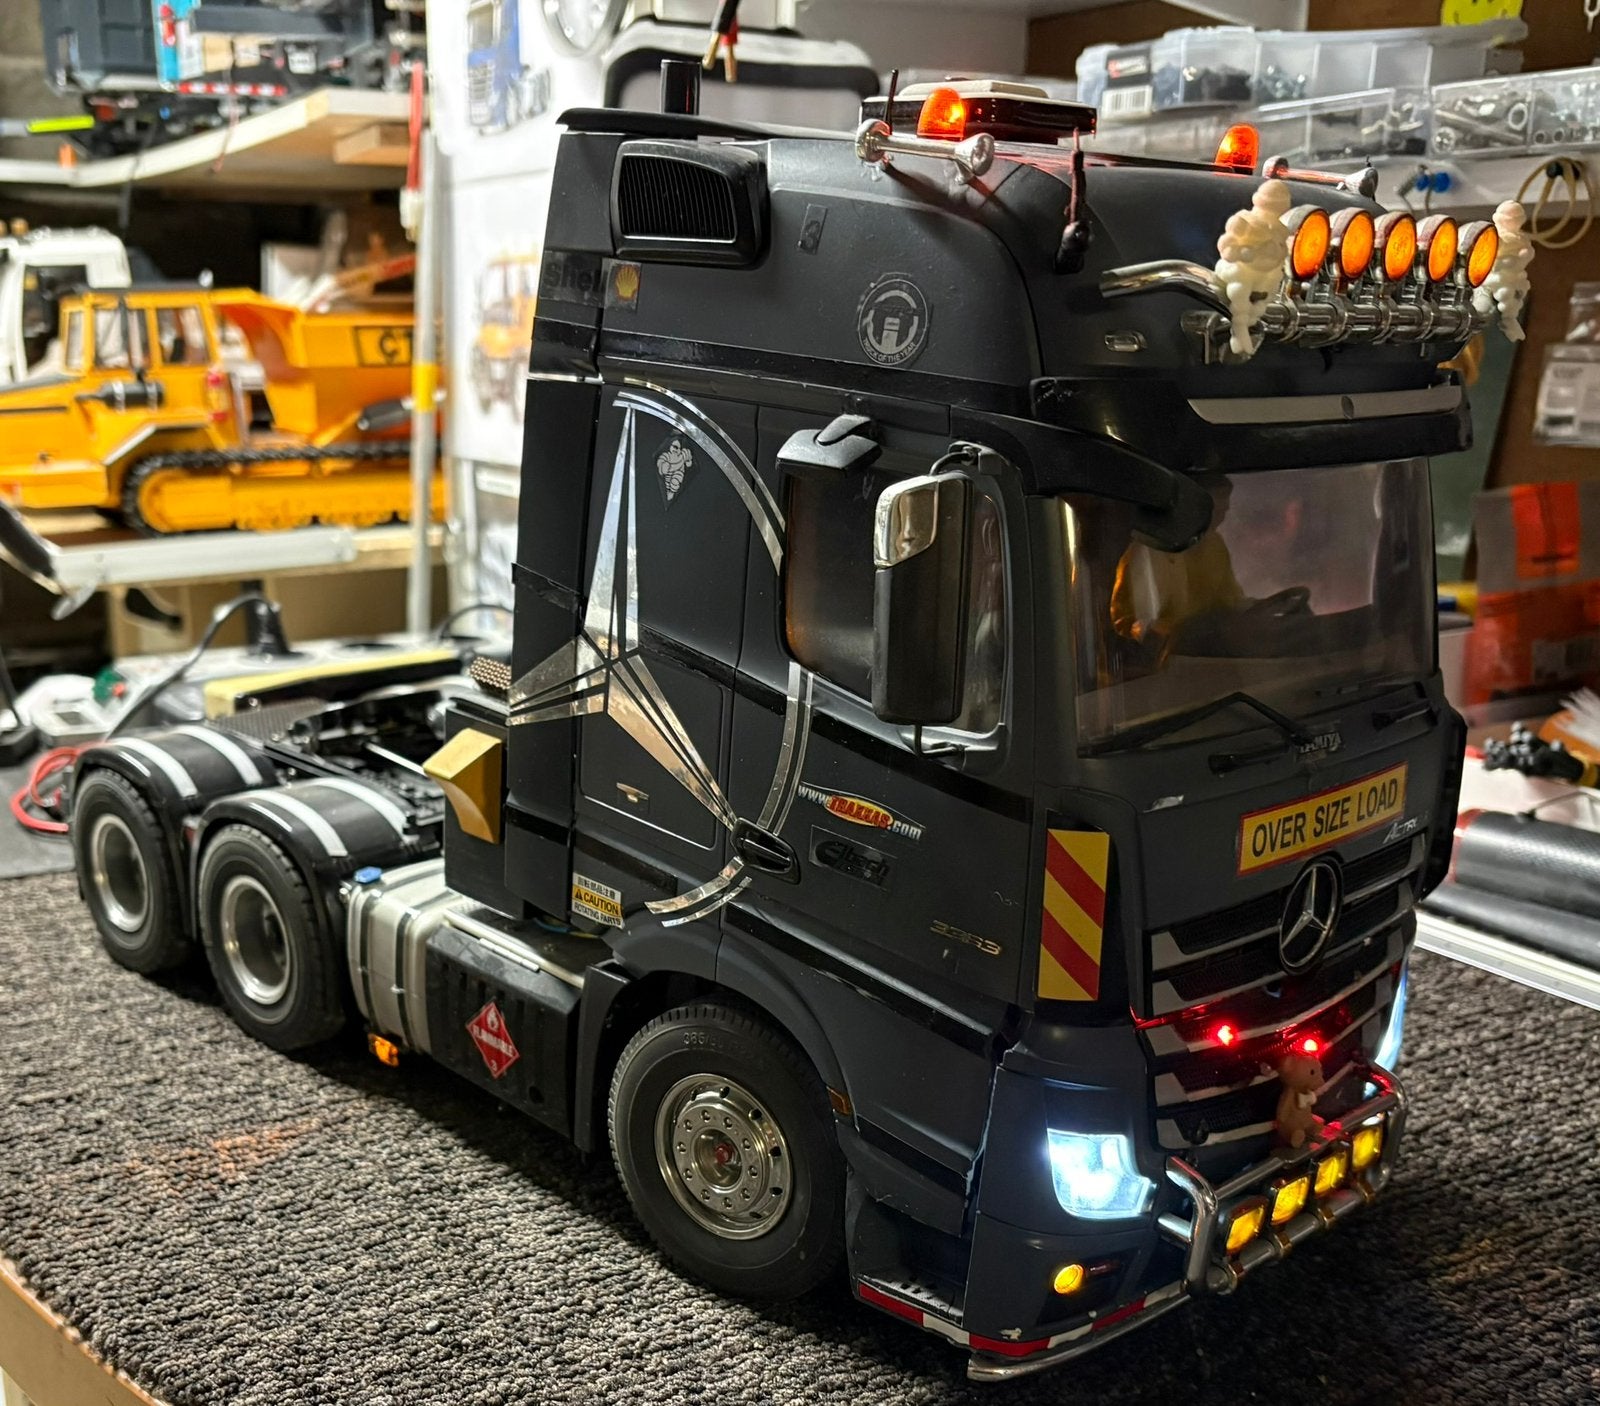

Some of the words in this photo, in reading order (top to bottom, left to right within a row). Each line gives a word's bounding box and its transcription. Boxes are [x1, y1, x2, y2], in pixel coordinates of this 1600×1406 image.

[878, 353, 887, 362] OF
[900, 341, 917, 358] YEAR
[1252, 812, 1306, 857] OVER
[1313, 795, 1351, 838] SIZE
[1357, 778, 1398, 822] LOAD
[574, 901, 600, 920] ROTATING
[600, 912, 622, 926] PARTS
[584, 892, 619, 916] CAUTION
